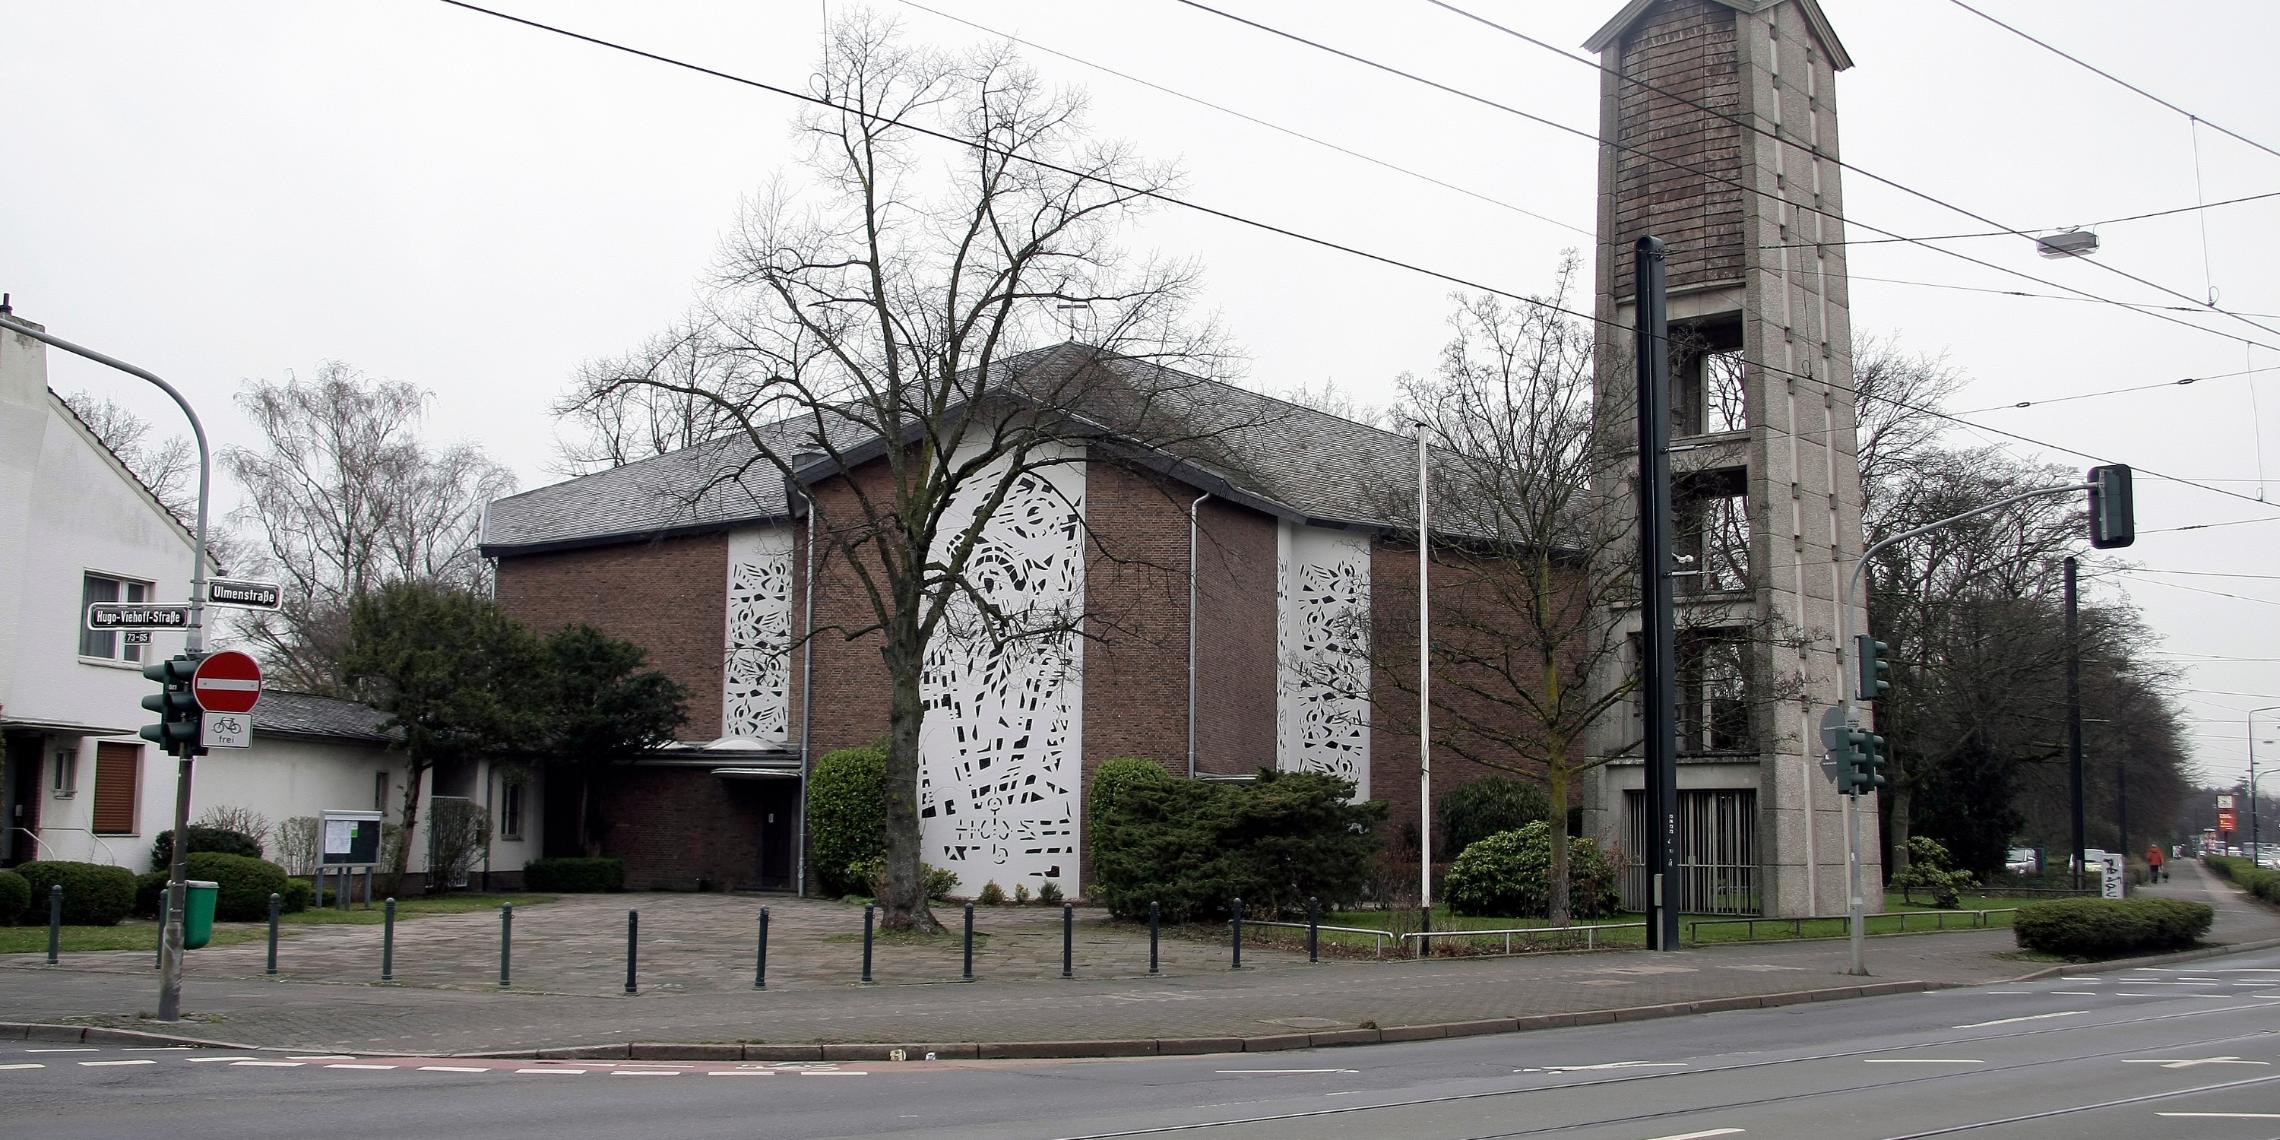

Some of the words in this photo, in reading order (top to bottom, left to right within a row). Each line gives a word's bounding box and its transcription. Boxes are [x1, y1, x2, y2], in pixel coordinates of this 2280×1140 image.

[213, 585, 275, 603] Ulmenstraße
[96, 610, 180, 624] Hugo-Viehoff-Straße
[219, 735, 235, 743] frei
